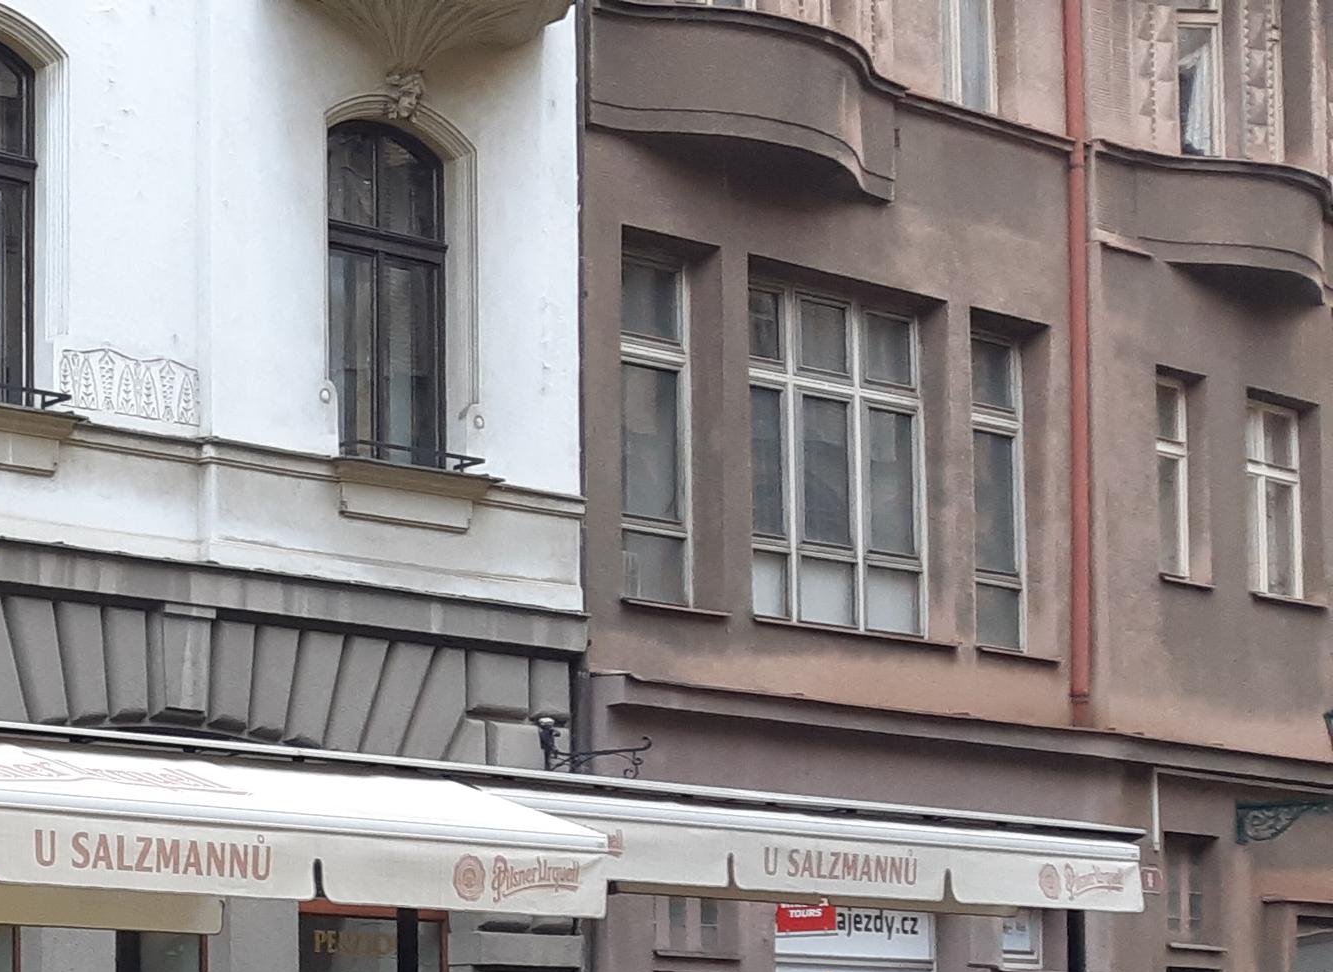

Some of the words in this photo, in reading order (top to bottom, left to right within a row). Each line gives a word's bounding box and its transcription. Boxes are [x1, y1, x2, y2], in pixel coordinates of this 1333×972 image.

[34, 829, 56, 867] U
[70, 831, 272, 882] SALZMANNŮ
[763, 846, 778, 876] U
[787, 848, 918, 886] SALZMANNŮ
[491, 855, 537, 902] Pilsner
[536, 857, 580, 893] Urquell
[788, 908, 823, 919] TOURS
[836, 907, 919, 941] ajezdy.cz
